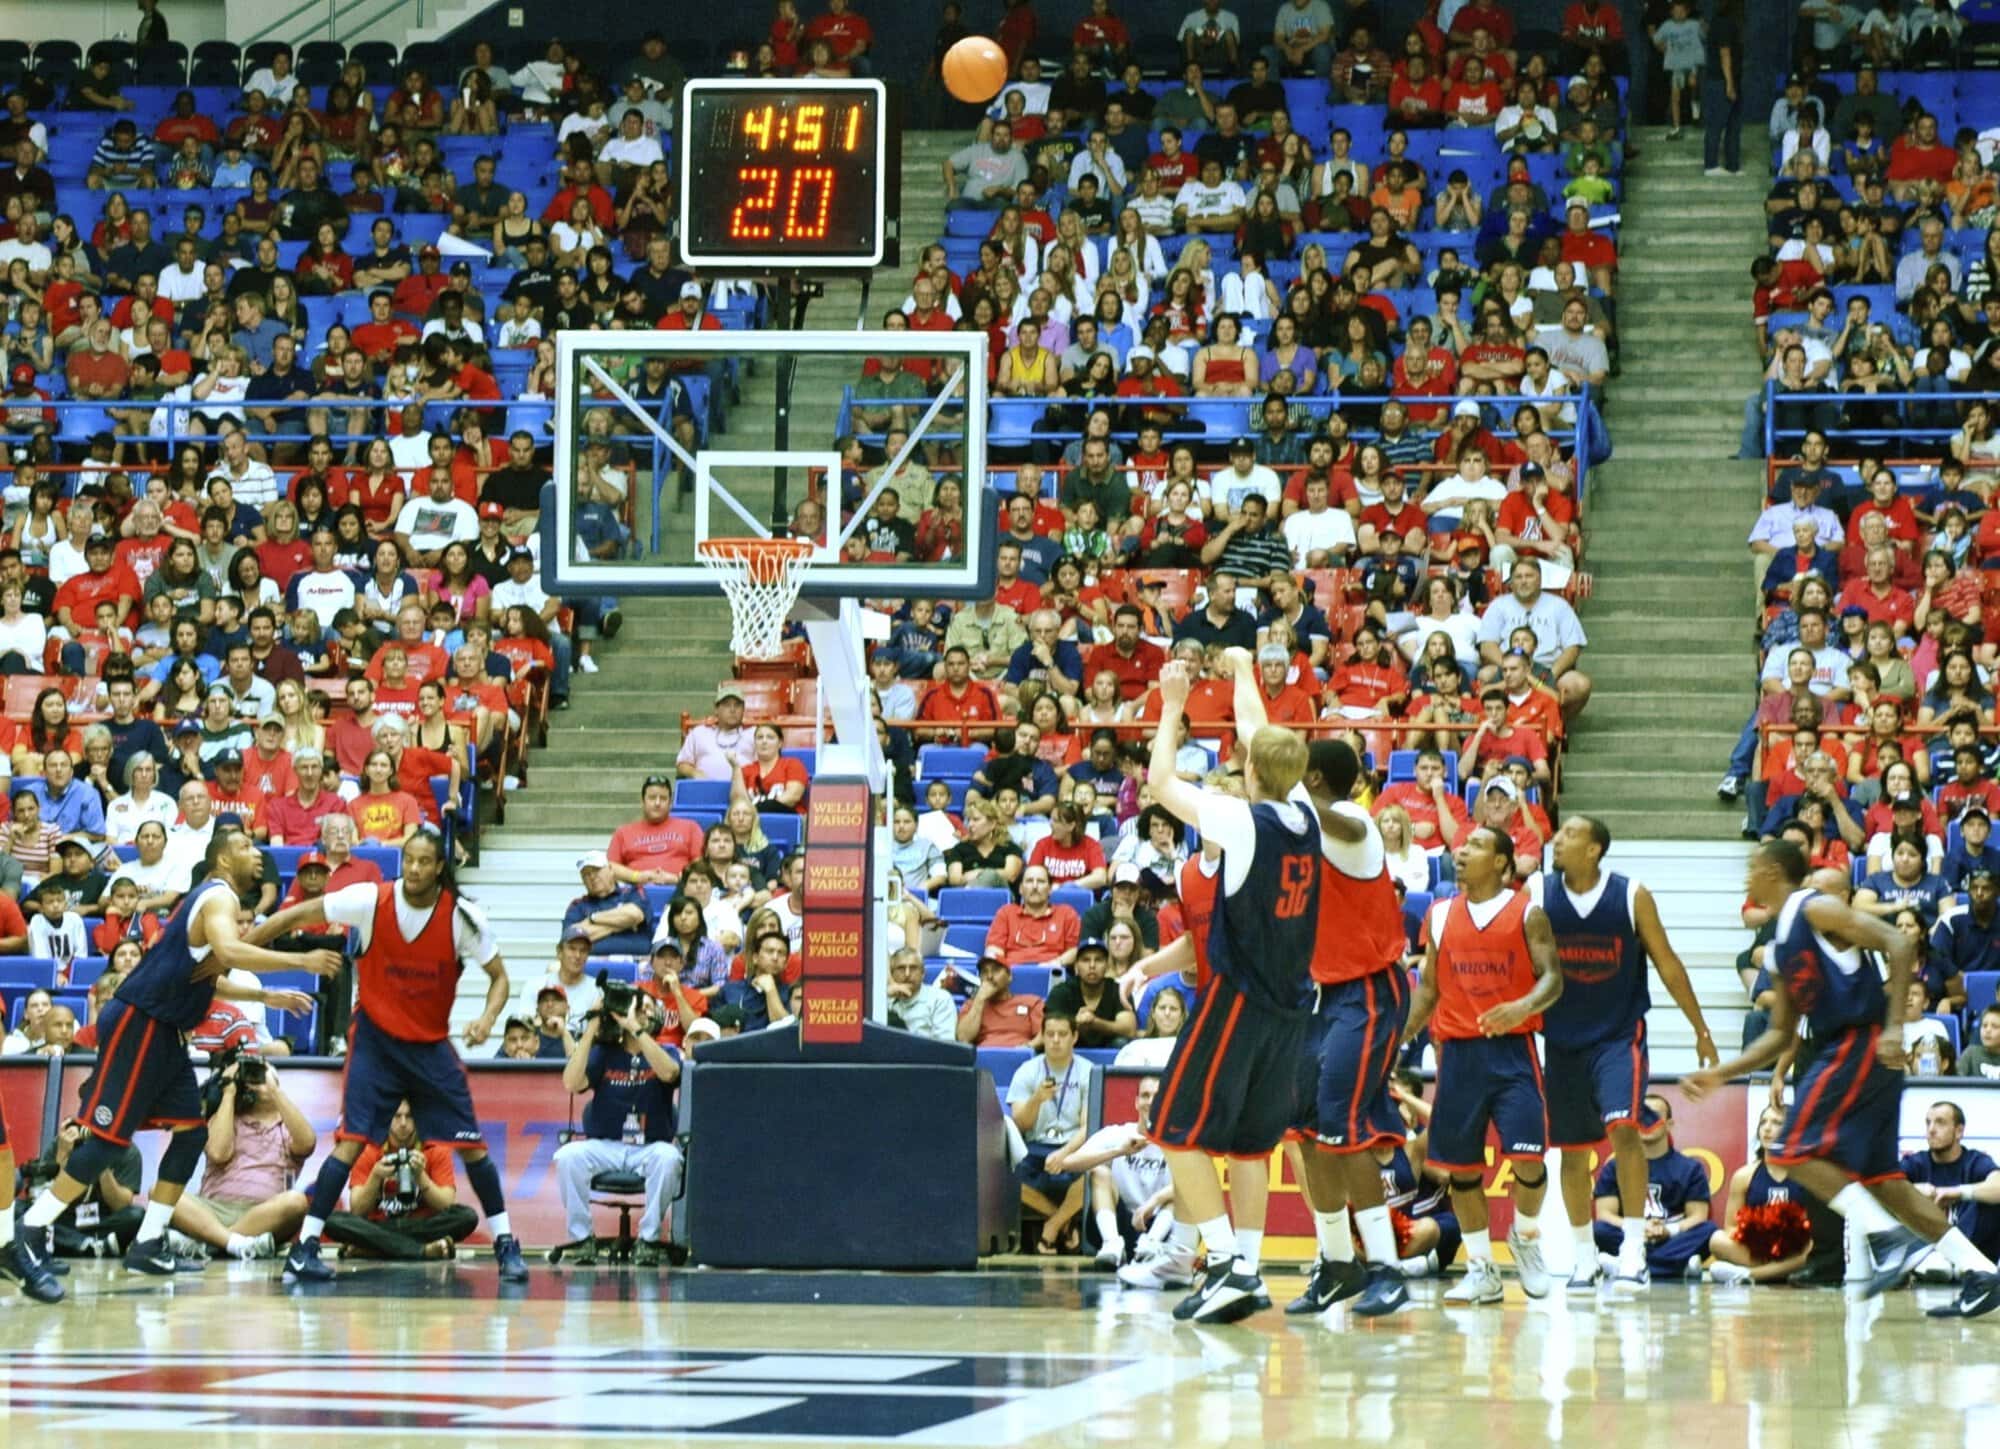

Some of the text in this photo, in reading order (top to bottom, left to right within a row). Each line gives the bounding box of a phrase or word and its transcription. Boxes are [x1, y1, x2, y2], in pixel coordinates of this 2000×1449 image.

[744, 105, 859, 150] 4:51
[732, 168, 832, 238] 20
[814, 802, 863, 814] WELLS
[814, 815, 862, 827] FARGO
[811, 866, 860, 878] WELLS
[810, 879, 859, 891] FARGO
[1275, 855, 1312, 918] 52
[808, 932, 858, 944] WELLS
[809, 945, 858, 957] FARGO
[1452, 961, 1506, 976] ARIZONA
[808, 1000, 858, 1012] WELLS
[809, 1012, 858, 1025] FARGO
